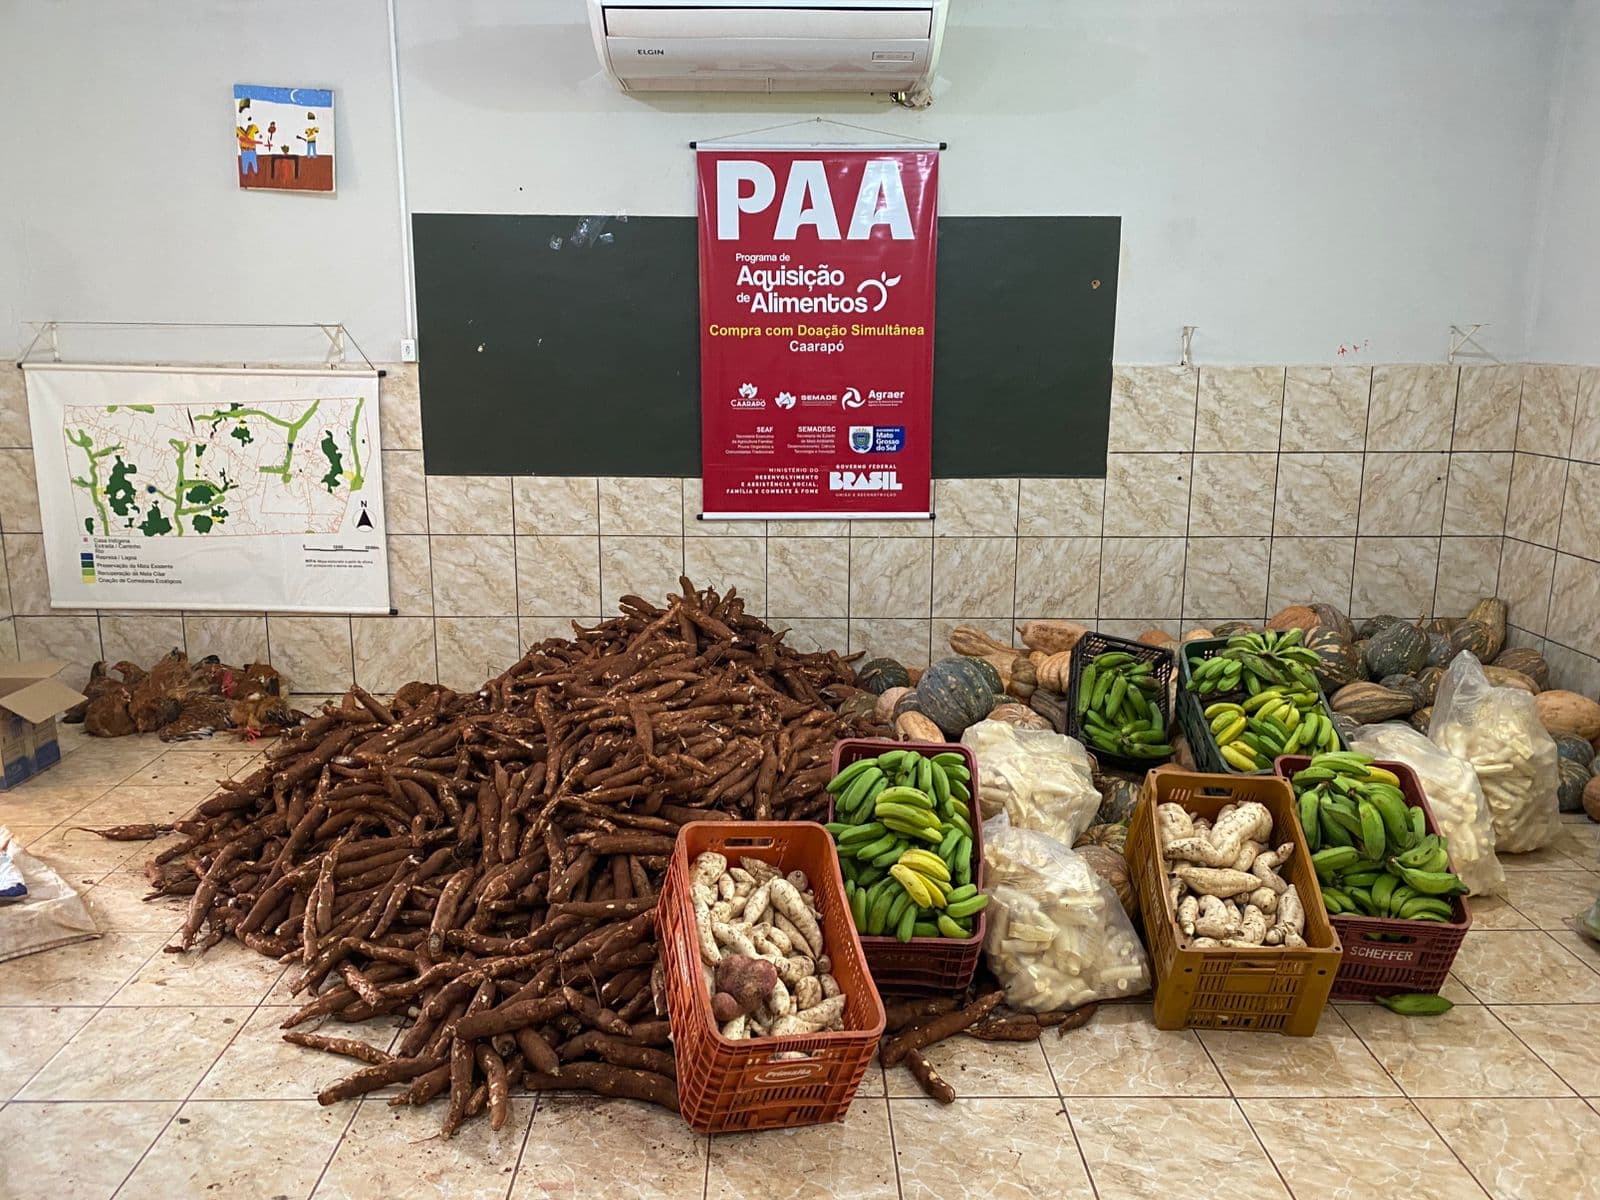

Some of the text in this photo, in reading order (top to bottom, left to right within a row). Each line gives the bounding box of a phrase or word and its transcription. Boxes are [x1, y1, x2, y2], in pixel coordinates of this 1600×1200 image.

[716, 160, 915, 240] PAA
[736, 252, 790, 264] Programa de
[736, 264, 844, 292] Aquisição
[736, 292, 868, 313] de Alimentos
[710, 324, 924, 339] Compra com Doação Simultânea
[790, 340, 844, 354] Caarapó
[868, 390, 905, 400] Agraer
[830, 472, 902, 490] BRASIL
[1350, 946, 1413, 960] SCHEFFER
